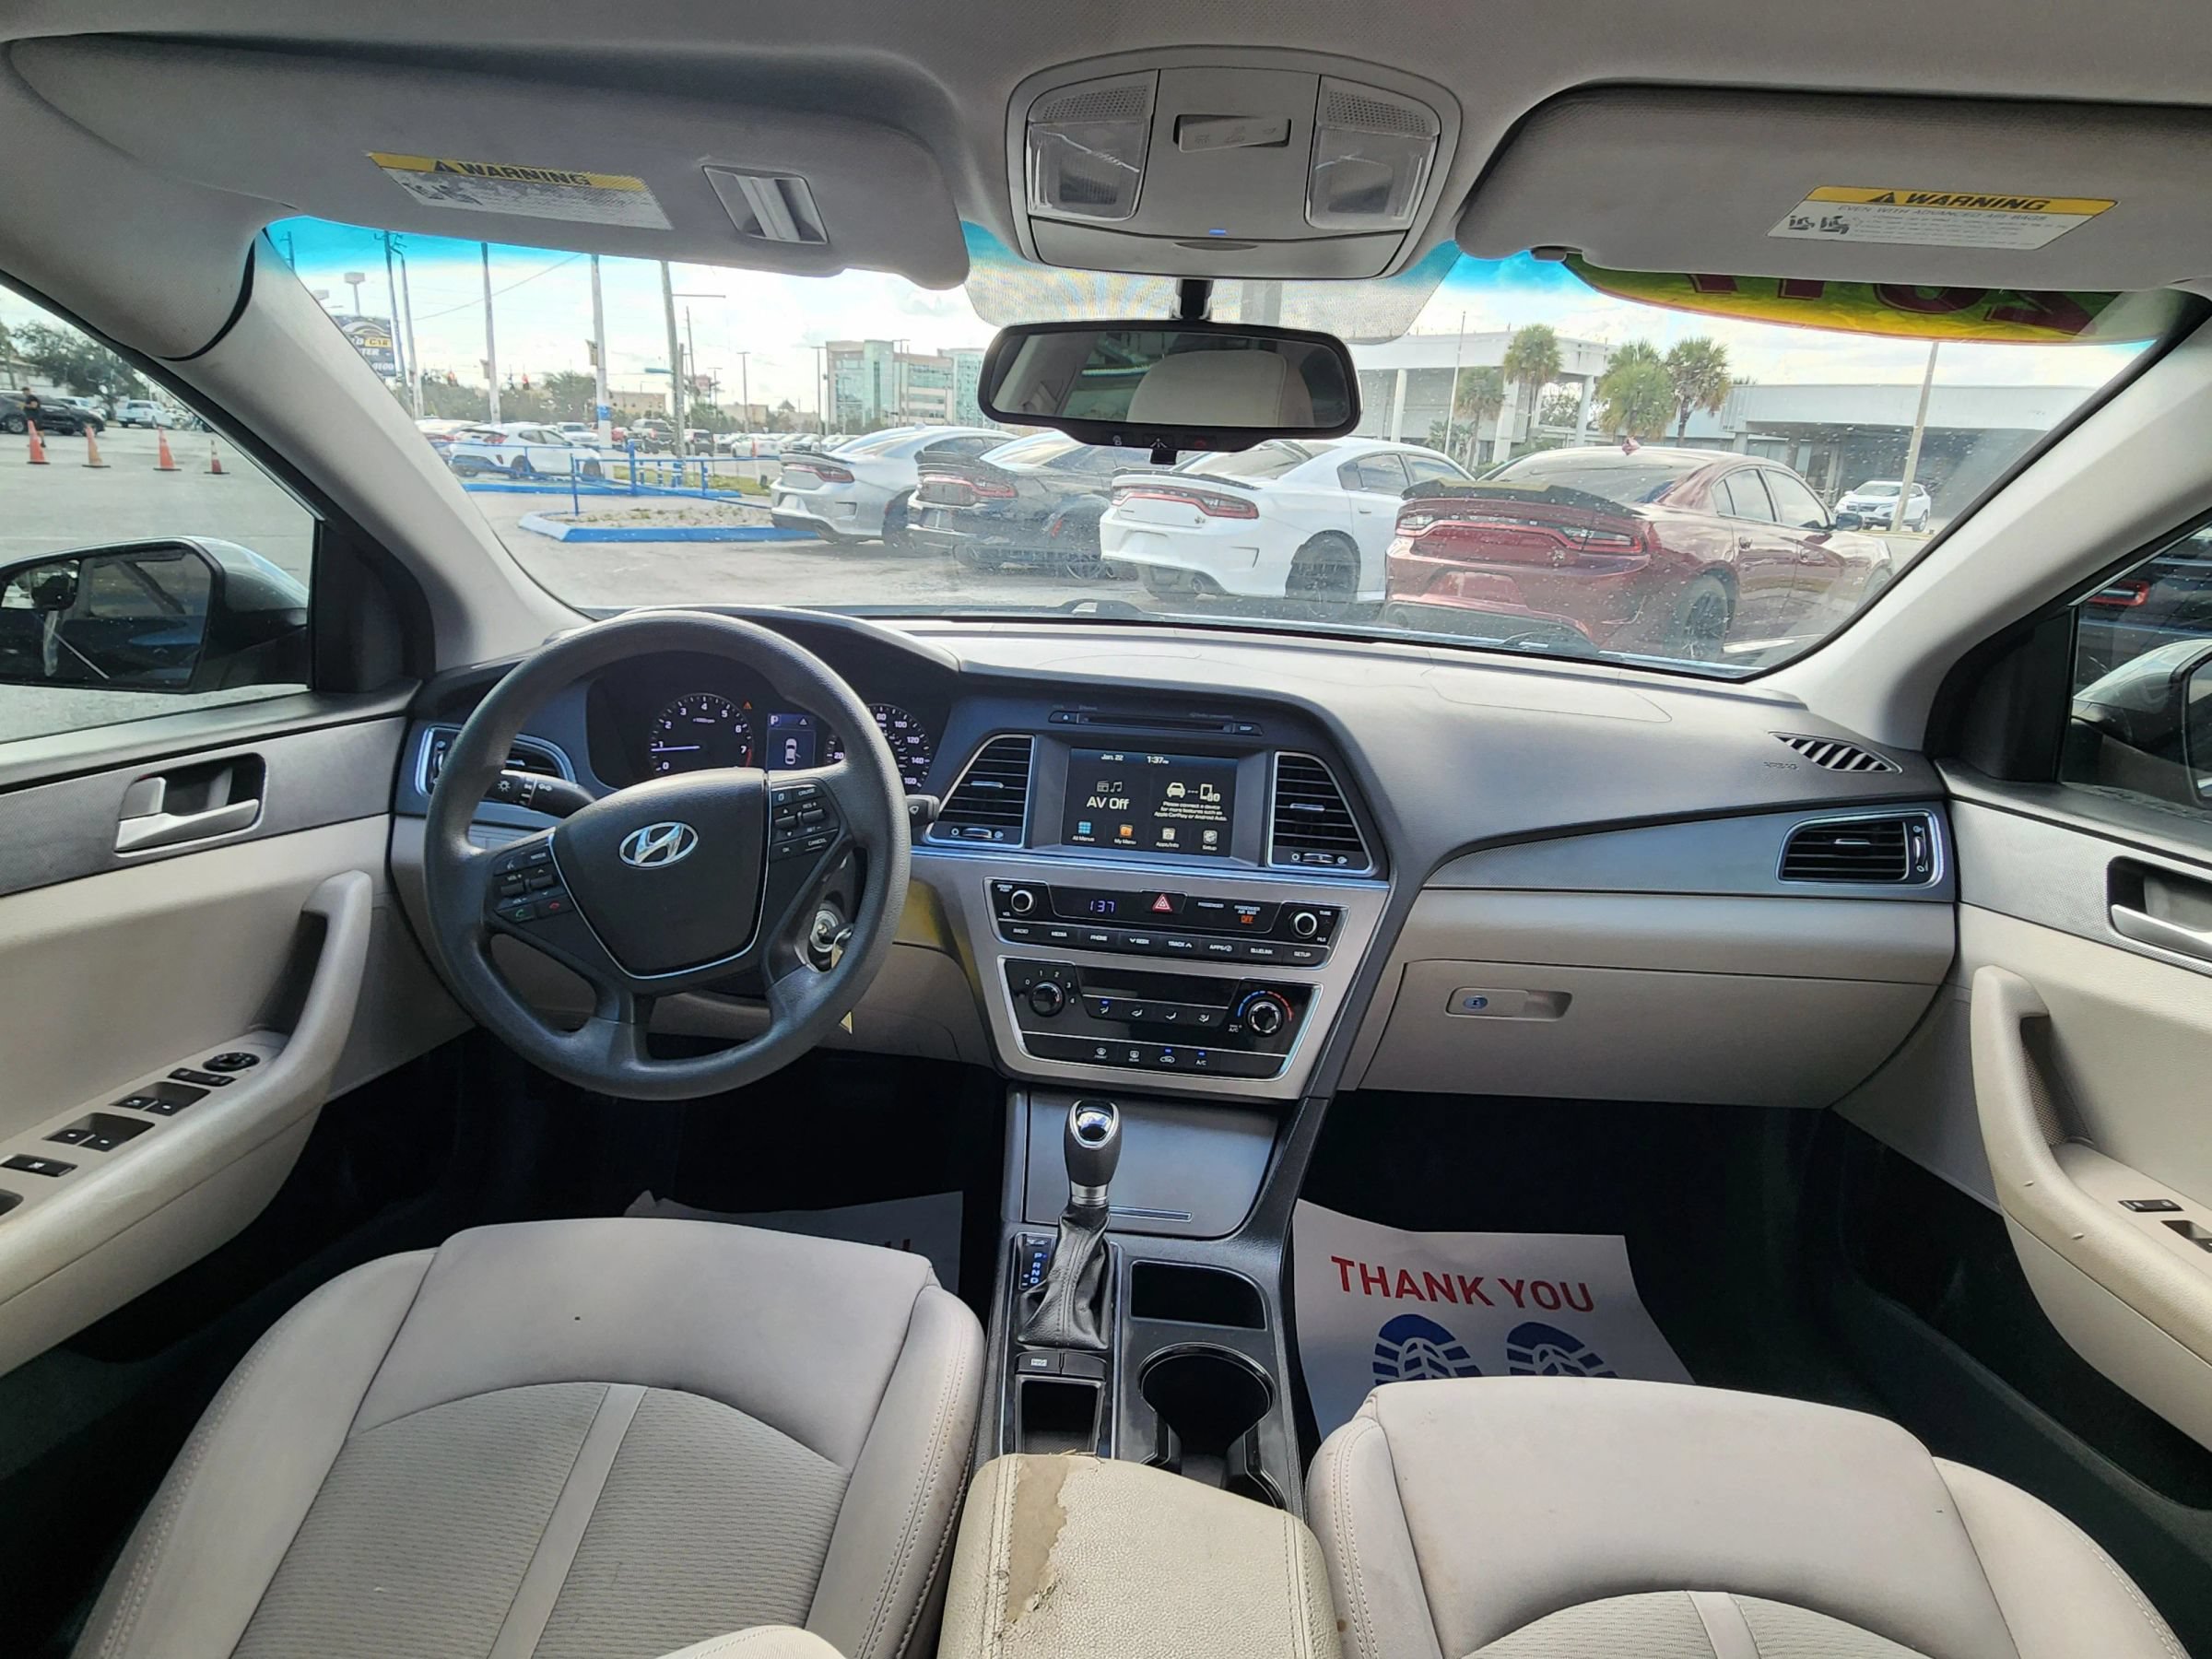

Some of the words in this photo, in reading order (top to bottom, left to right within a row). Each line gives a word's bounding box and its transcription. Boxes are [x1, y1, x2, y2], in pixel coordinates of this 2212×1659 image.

[460, 162, 592, 186] WARNING
[1906, 193, 2051, 211] WARNING
[1837, 205, 1871, 213] EVEN
[1914, 208, 1983, 218] ADVANCED
[679, 707, 687, 715] 3
[700, 702, 708, 711] 4
[721, 710, 728, 718] 5
[665, 721, 672, 729] 2
[735, 724, 742, 733] 6
[740, 746, 747, 754] 7
[662, 761, 669, 770] 0
[904, 777, 917, 785] 160
[1086, 796, 1107, 808] AV
[1109, 797, 1130, 810] Off
[1240, 915, 1254, 924] OFF
[1331, 1255, 1495, 1307] THANK
[1498, 1277, 1595, 1312] YOU
